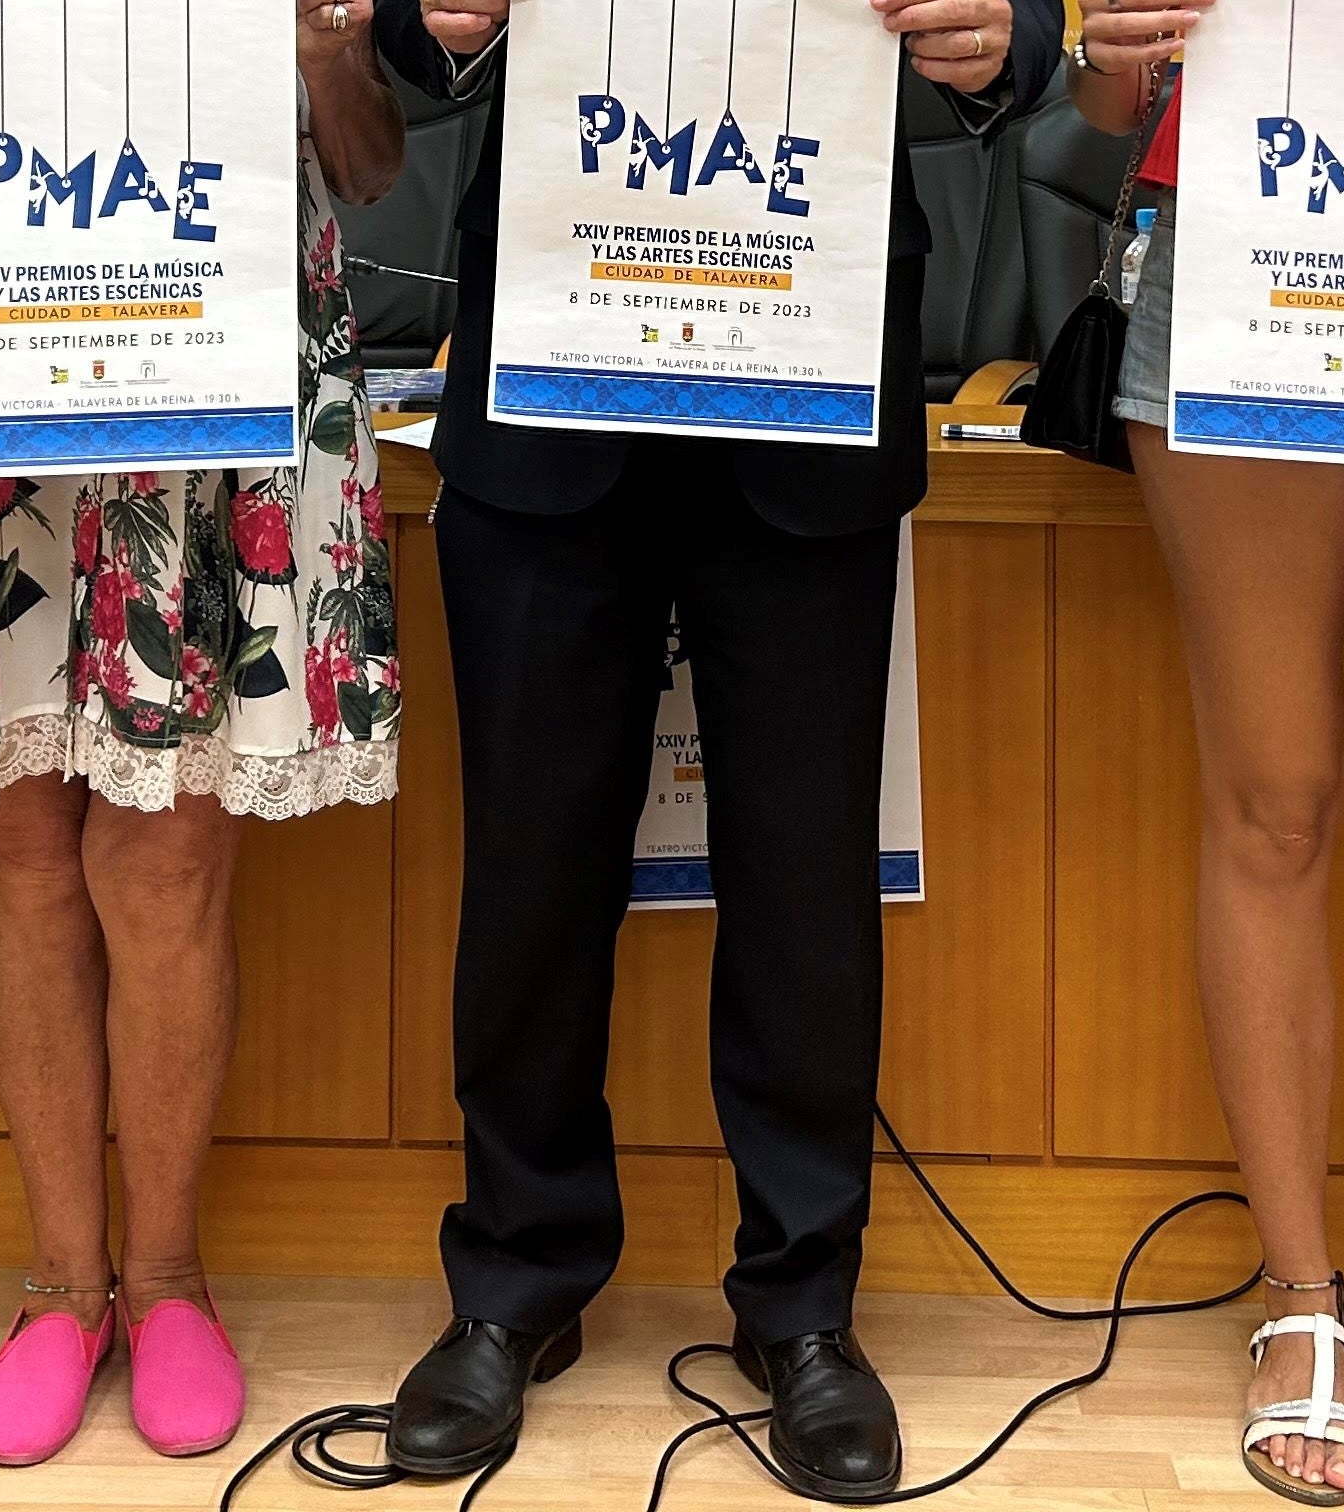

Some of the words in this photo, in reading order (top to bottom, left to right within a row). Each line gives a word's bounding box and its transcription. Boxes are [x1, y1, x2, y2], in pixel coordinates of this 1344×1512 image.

[578, 94, 820, 217] PMAE
[572, 223, 609, 239] XXIV
[614, 226, 691, 245] PREMIOS
[696, 230, 717, 246] DE
[722, 232, 741, 247] LA
[747, 230, 814, 251] MÚSICA
[592, 244, 602, 258] Y
[606, 245, 636, 260] LAS
[640, 247, 693, 264] ARTES
[699, 248, 792, 270] ESCÉNICAS
[1251, 249, 1289, 266] XXIV
[16, 264, 96, 281] PREMIOS
[102, 264, 124, 279] DE
[129, 263, 149, 279] LA
[155, 258, 223, 277] MÚSICA
[606, 266, 664, 279] CIUDAD
[675, 269, 693, 281] DE
[703, 271, 778, 286] TALAVERA
[1271, 271, 1281, 286] Y
[1286, 272, 1317, 288] LAS
[9, 287, 40, 302] LAS
[45, 285, 100, 301] ARTES
[106, 280, 202, 300] ESCÉNICAS
[9, 308, 70, 320] CIUDAD
[82, 307, 101, 318] DE
[112, 304, 189, 316] TALAVERA
[570, 292, 578, 304] 8
[590, 293, 612, 305] DE
[623, 294, 727, 312] SEPTIEMBRE
[740, 302, 761, 314] DE
[772, 304, 812, 317] 2023
[1249, 320, 1257, 332] 8
[1270, 321, 1292, 333] DE
[29, 334, 138, 349] SEPTIEMBRE
[151, 333, 173, 345] DE
[184, 332, 225, 344] 2023
[550, 352, 589, 363] TEATRO
[593, 354, 643, 366] VICTORIA
[656, 358, 708, 370] TALAVERA
[713, 361, 726, 370] DE
[730, 362, 742, 371] LA
[747, 363, 778, 374] REINA
[1230, 380, 1271, 392] TEATRO
[1275, 383, 1326, 395] VICTORIA
[2, 400, 54, 409] VICTORIA
[67, 397, 122, 408] TALAVERA
[127, 397, 141, 406] DE
[145, 396, 157, 405] LA
[162, 395, 194, 404] REINA
[656, 735, 686, 748] XXIV
[673, 751, 681, 764] Y
[686, 752, 703, 764] LA
[658, 793, 665, 804] 8
[676, 793, 693, 803] DE
[647, 845, 679, 853] TEATRO
[683, 844, 708, 852] VICTO
